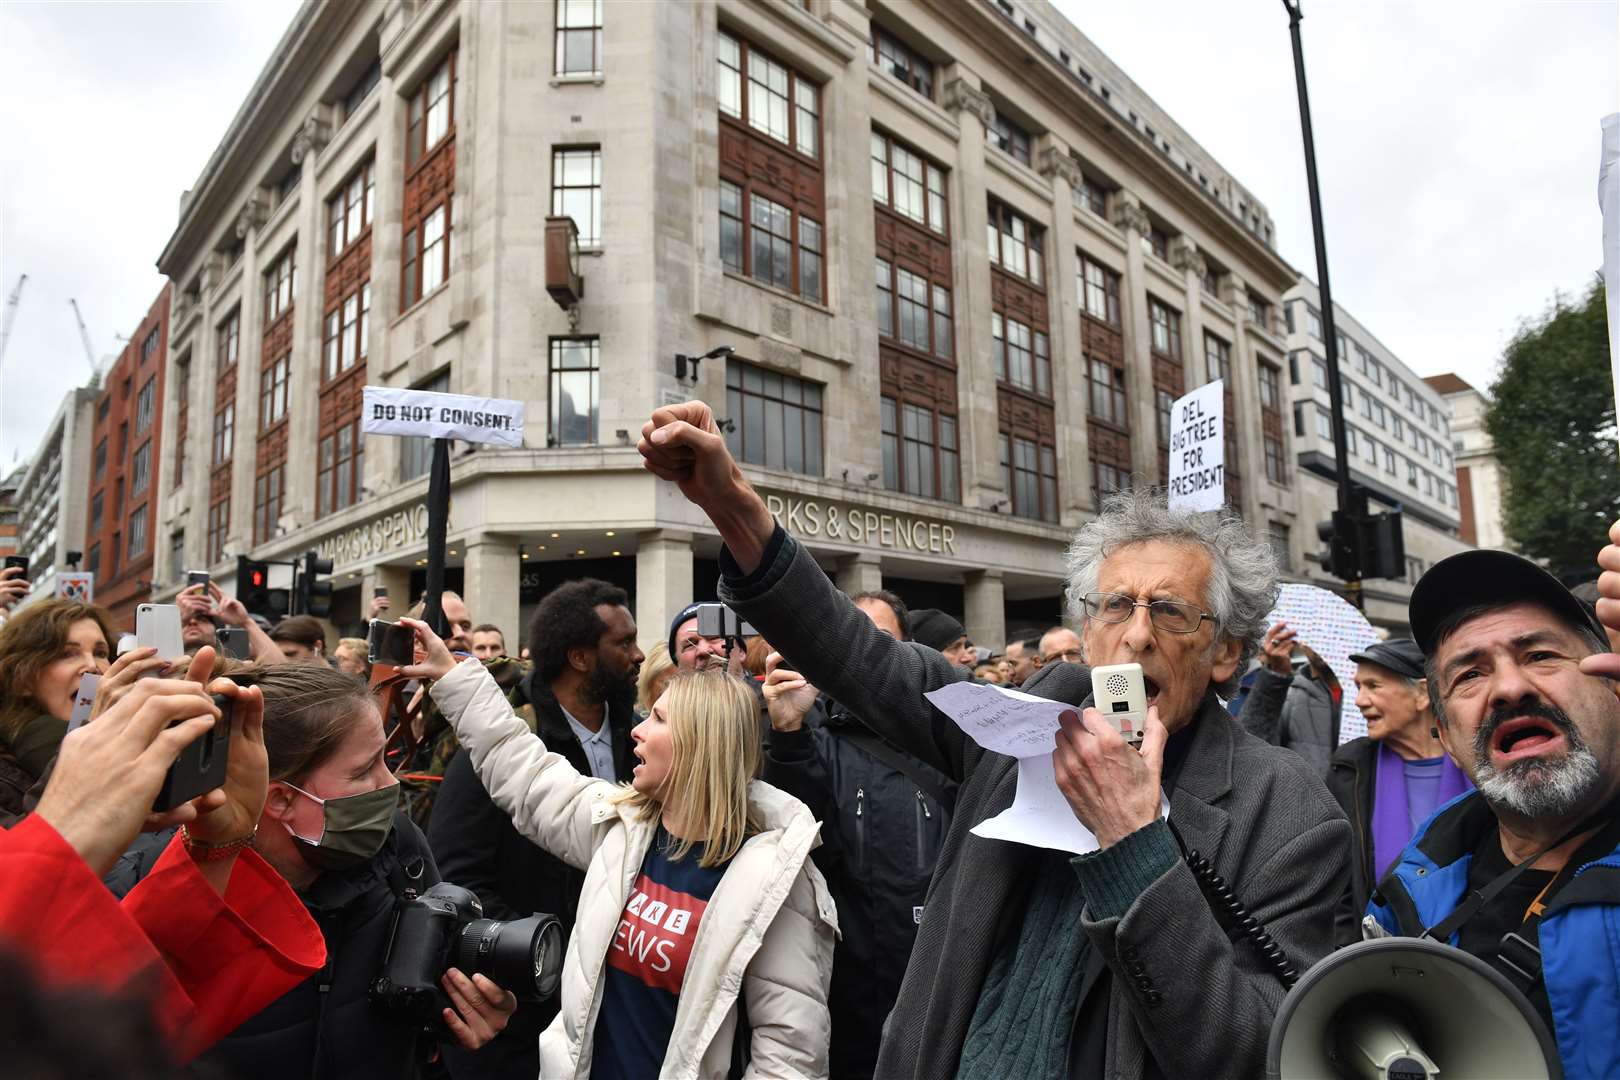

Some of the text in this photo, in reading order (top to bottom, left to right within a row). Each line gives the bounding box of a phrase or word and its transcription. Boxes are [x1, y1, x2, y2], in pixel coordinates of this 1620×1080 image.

[373, 404, 516, 431] DO NOT CONSENT.
[1182, 399, 1204, 423] DEL
[1183, 447, 1203, 471] FOR
[1171, 464, 1223, 496] PRESIDENT
[373, 503, 429, 553] SPENC
[766, 495, 956, 555] RKS & SPENCER
[628, 896, 688, 932] AKE
[613, 919, 676, 972] EWS
